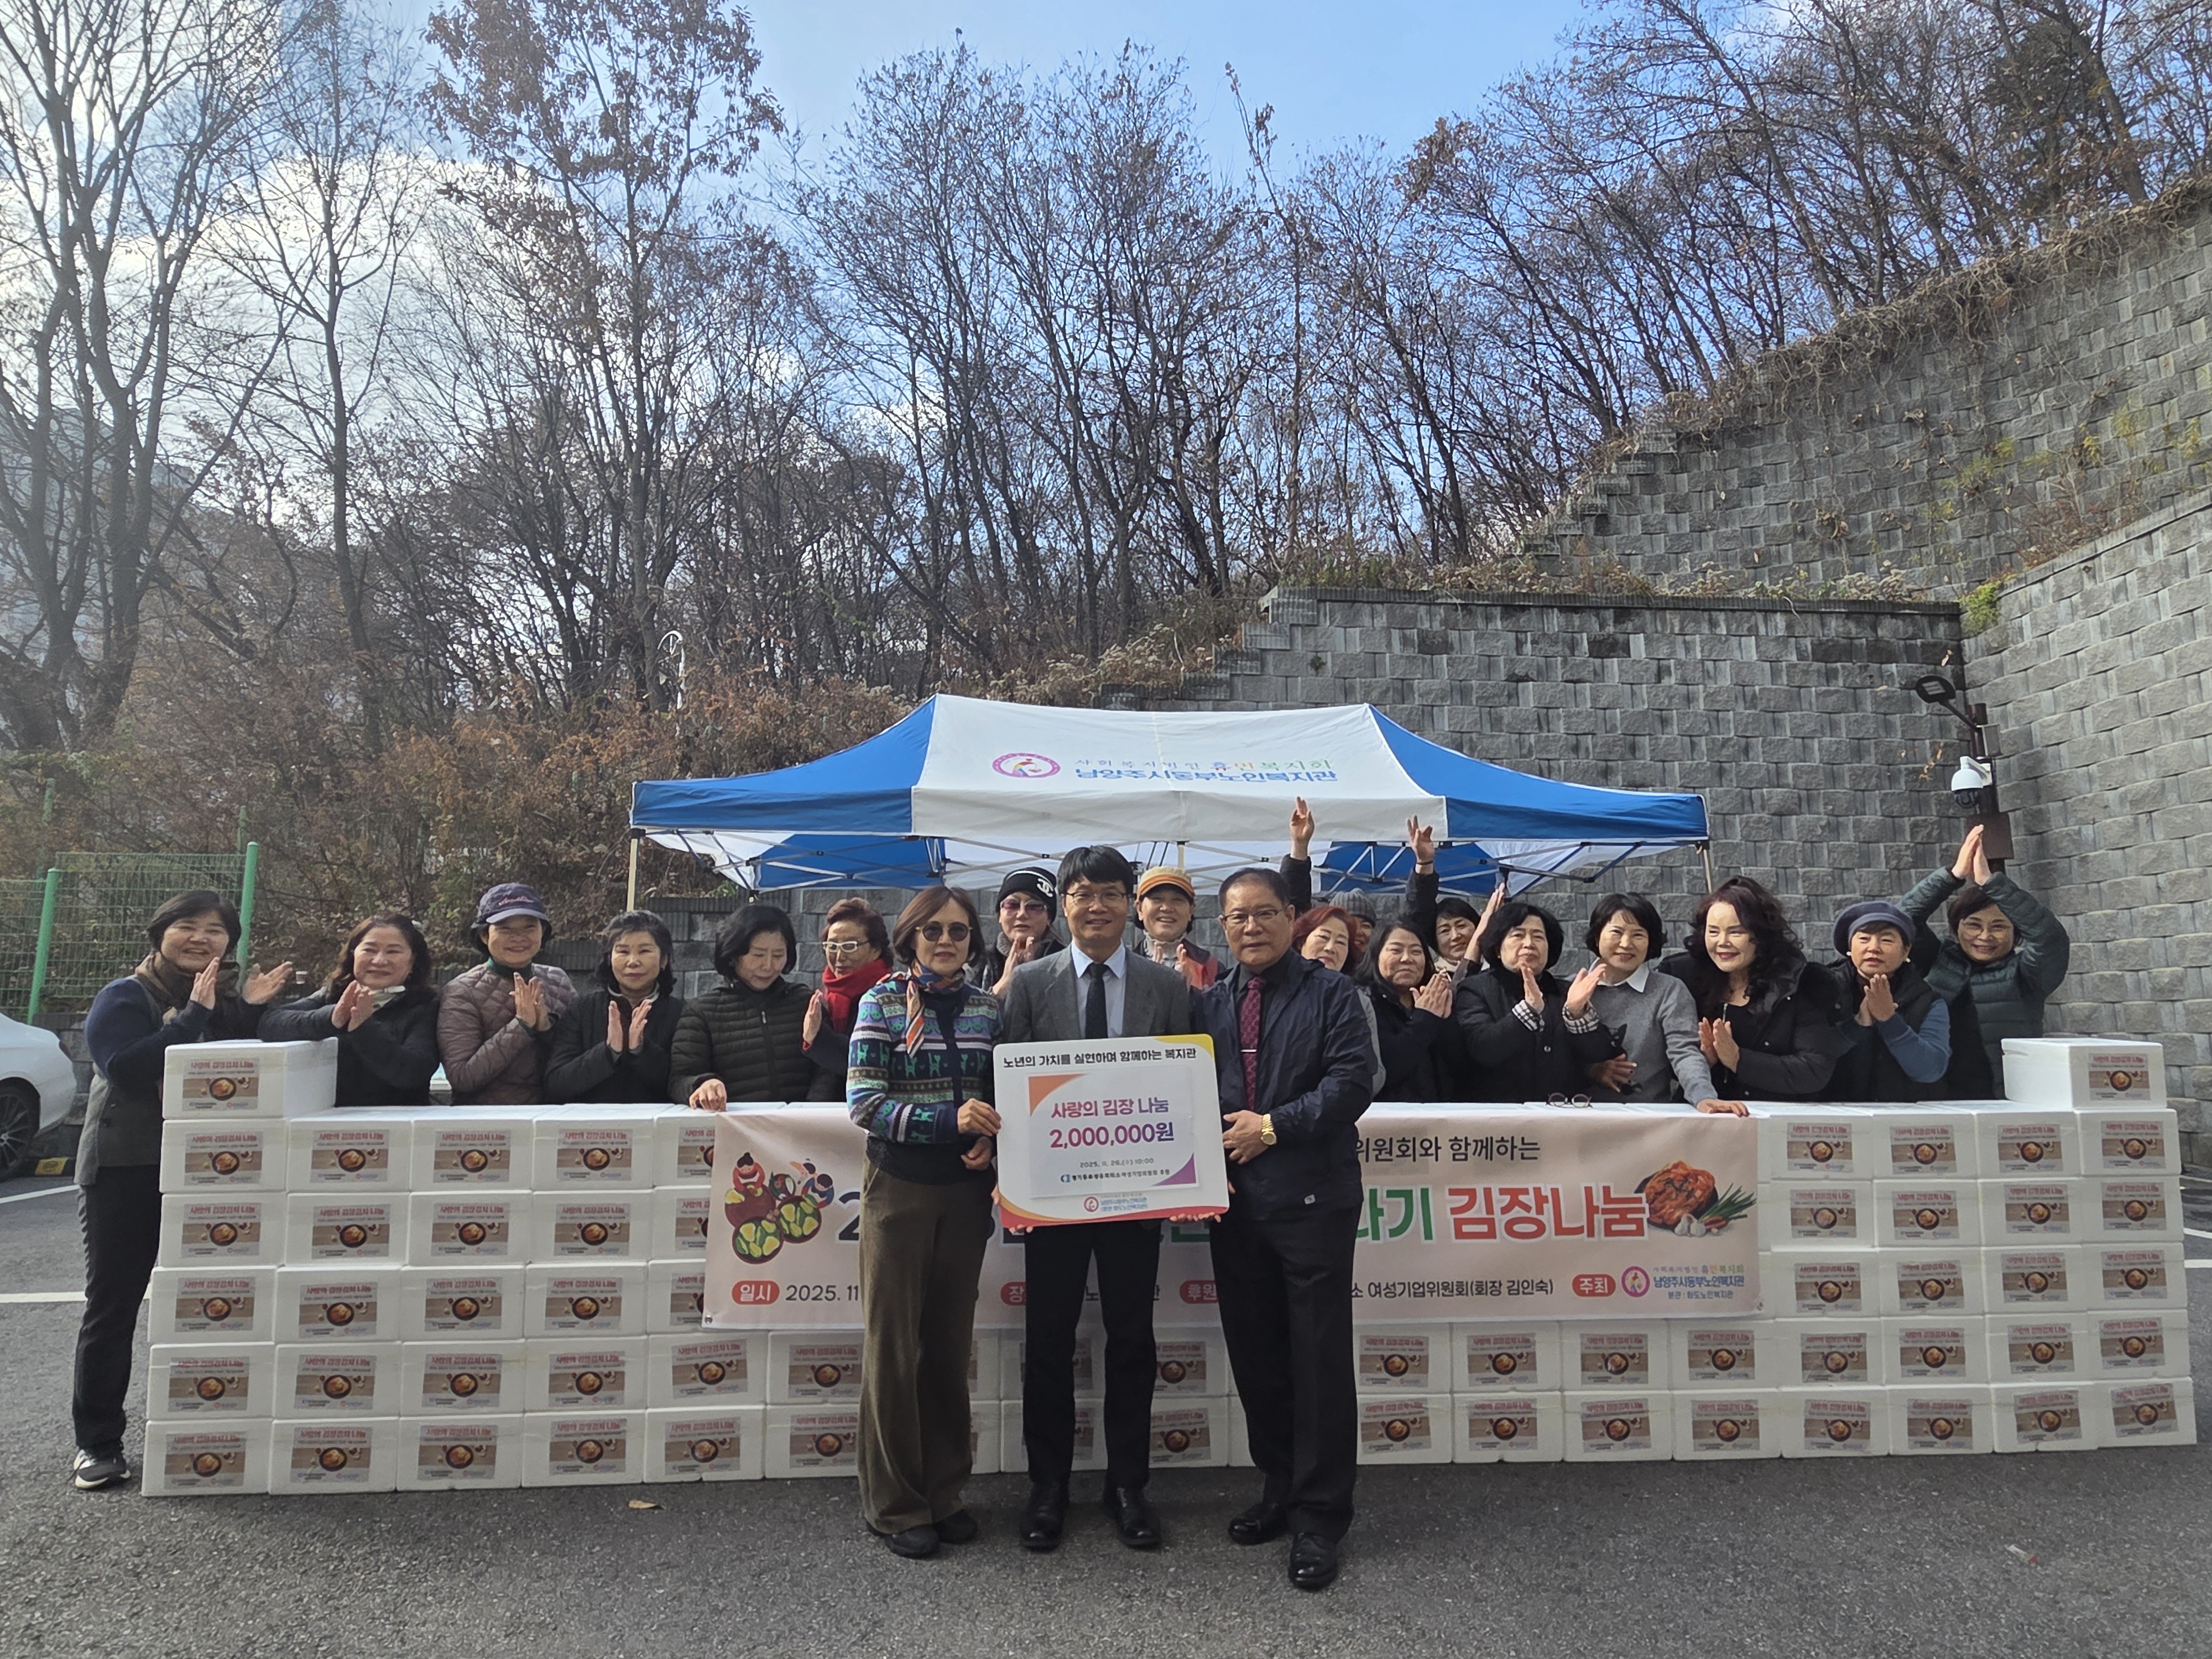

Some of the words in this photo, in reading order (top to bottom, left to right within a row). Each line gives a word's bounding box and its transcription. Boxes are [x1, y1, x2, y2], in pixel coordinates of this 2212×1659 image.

[1076, 769, 1338, 782] 남양주시동부노인복지관
[1003, 1055, 1036, 1068] 노년의
[1039, 1053, 1071, 1066] 가치를
[1074, 1052, 1117, 1065] 실현하며
[1119, 1050, 1162, 1062] 함께하는
[1165, 1048, 1197, 1059] 복지관
[1051, 1100, 1099, 1119] 사랑의
[1102, 1098, 1134, 1116] 김장
[1138, 1097, 1169, 1114] 나눔
[1049, 1121, 1174, 1149] 2,000,000원
[1448, 1135, 1541, 1162] 함께하는
[1448, 1186, 1646, 1240] 김장나눔
[1368, 1280, 1503, 1298] 여성기업위원회(회장
[1506, 1279, 1554, 1296] 김인숙)
[1579, 1277, 1608, 1294] 주최
[1653, 1275, 1745, 1288] 남양주시동부노인복지관
[740, 1284, 771, 1302] 일시
[785, 1285, 841, 1301] 2025.
[1187, 1283, 1217, 1301] 후원
